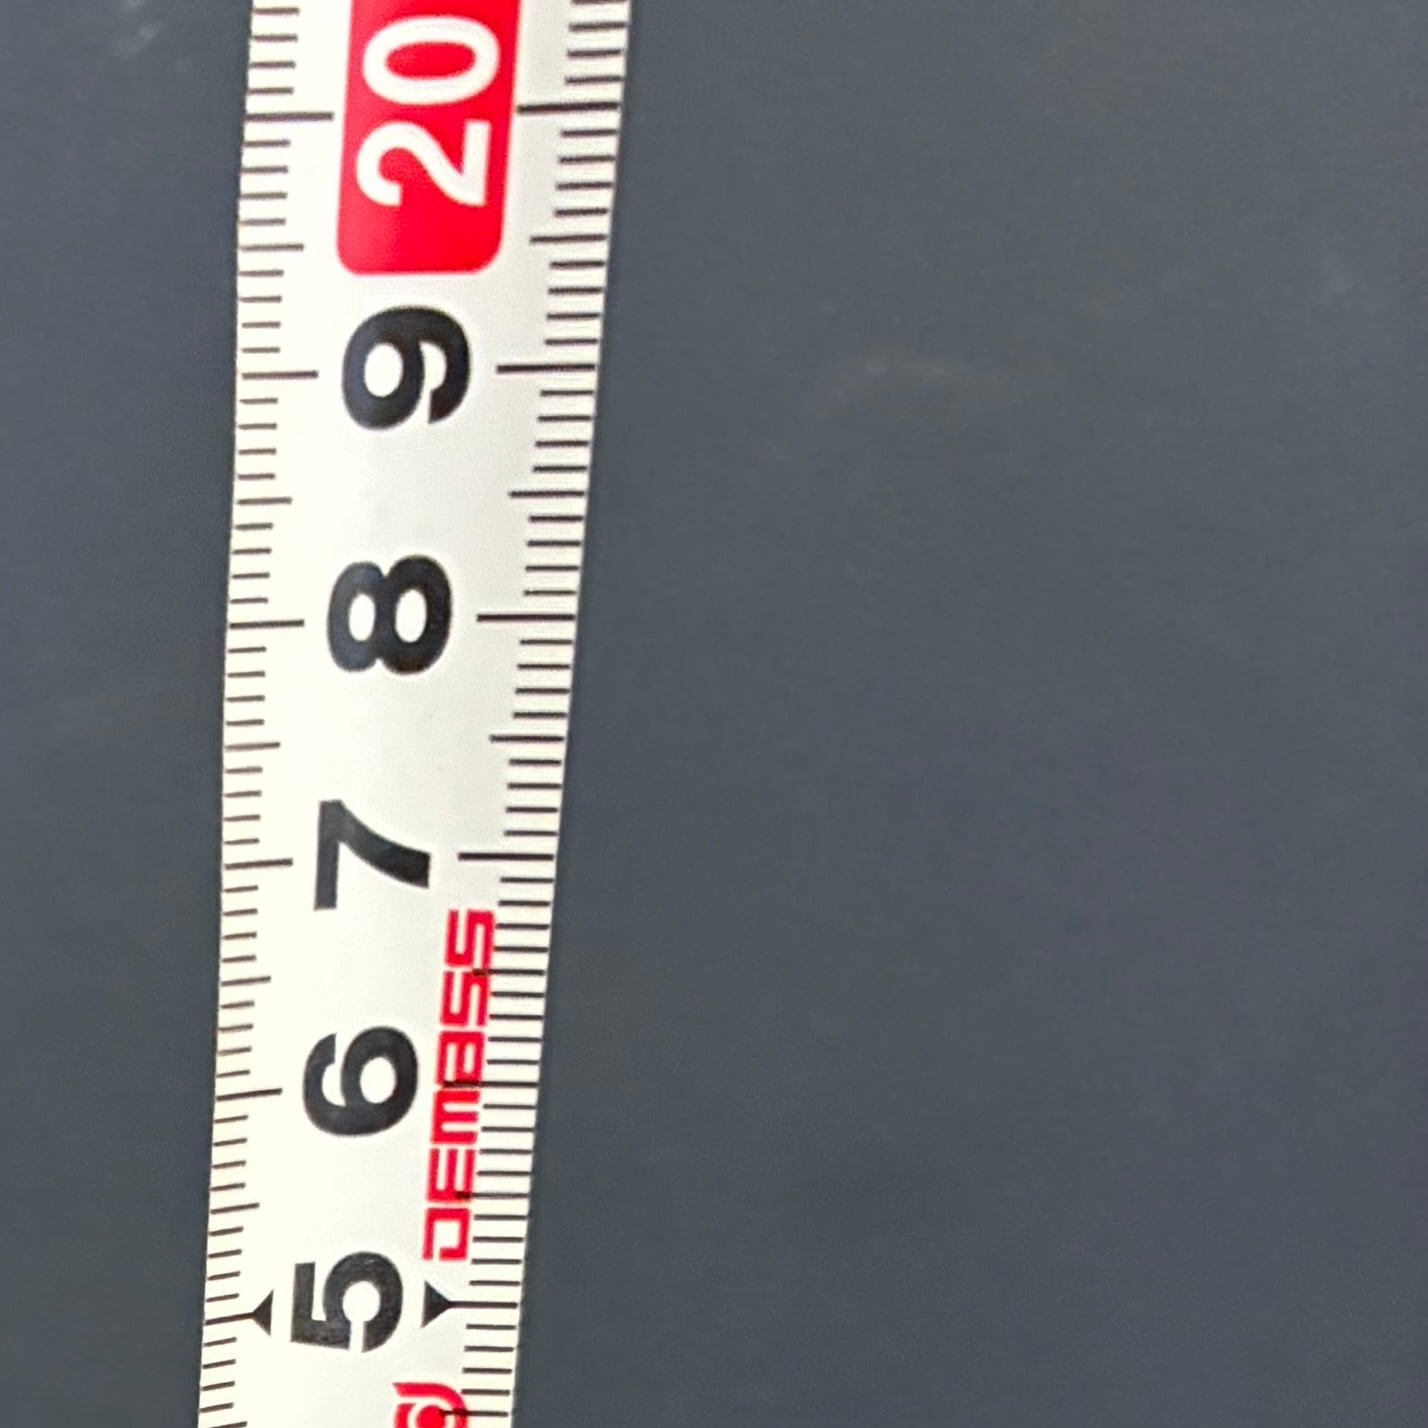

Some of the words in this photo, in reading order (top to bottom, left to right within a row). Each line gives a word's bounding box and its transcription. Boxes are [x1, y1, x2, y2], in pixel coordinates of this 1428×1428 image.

[355, 16, 500, 207] 20
[343, 304, 471, 430] 9
[326, 554, 452, 674] 8
[314, 800, 432, 911] 7
[303, 1026, 419, 1137] 6
[290, 1251, 404, 1352] 5
